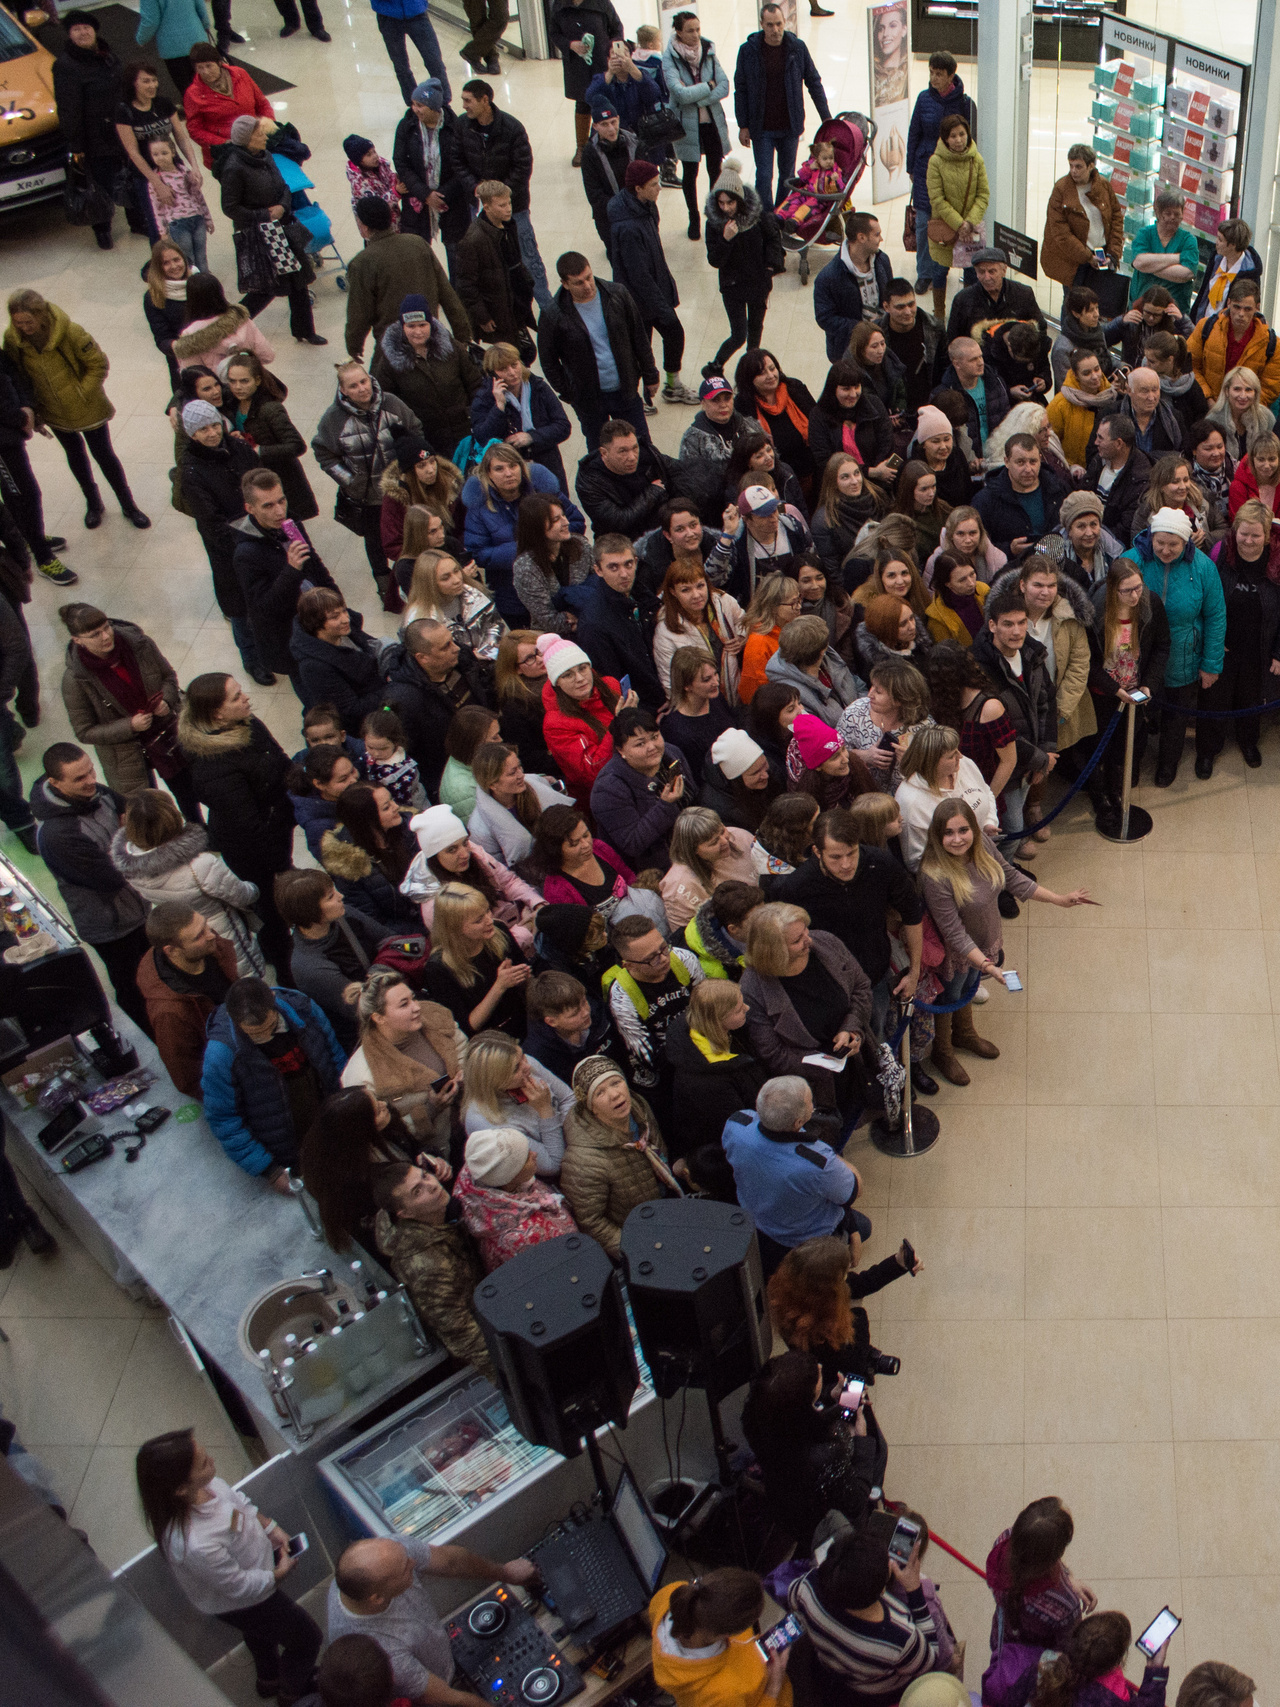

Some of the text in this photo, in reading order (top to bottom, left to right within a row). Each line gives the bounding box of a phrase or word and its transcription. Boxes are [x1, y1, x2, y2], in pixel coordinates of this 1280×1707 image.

[1114, 29, 1156, 52] НОВИНКИ
[1186, 56, 1230, 80] НОВИНКИ
[17, 178, 46, 190] XRAY
[677, 884, 699, 905] BAB
